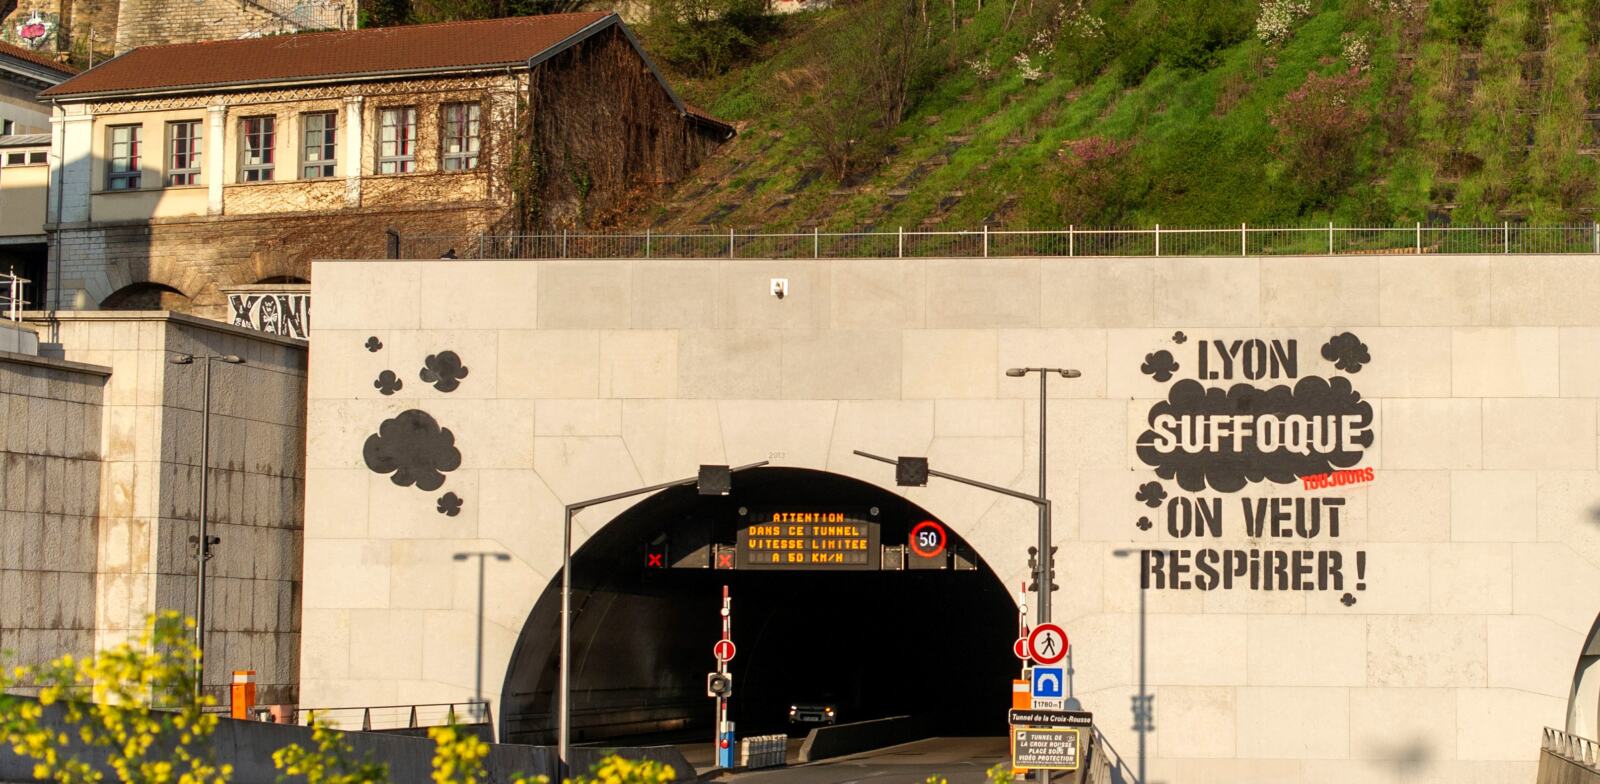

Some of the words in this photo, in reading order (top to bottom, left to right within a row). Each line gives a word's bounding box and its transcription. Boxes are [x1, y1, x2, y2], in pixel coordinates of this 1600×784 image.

[1198, 338, 1298, 380] LYON
[1153, 413, 1364, 456] SUFFOQUE
[1301, 467, 1375, 491] TOUJOURS
[773, 512, 844, 523] ATTENTION
[1167, 496, 1223, 539] ON
[1242, 497, 1346, 539] VEUT
[749, 526, 780, 536] DANS
[788, 526, 804, 536] CE
[813, 526, 860, 536] TUNNEL
[749, 539, 804, 550] VITESSE
[812, 539, 867, 550] LIMITEE
[919, 531, 937, 547] 50
[772, 553, 780, 563] A
[788, 553, 804, 563] 50
[811, 553, 843, 563] KM/H
[1012, 713, 1033, 722] Tunnel
[1034, 714, 1042, 722] de
[1050, 715, 1091, 724] Croix-Rousse
[1028, 747, 1047, 755] PLACÉ
